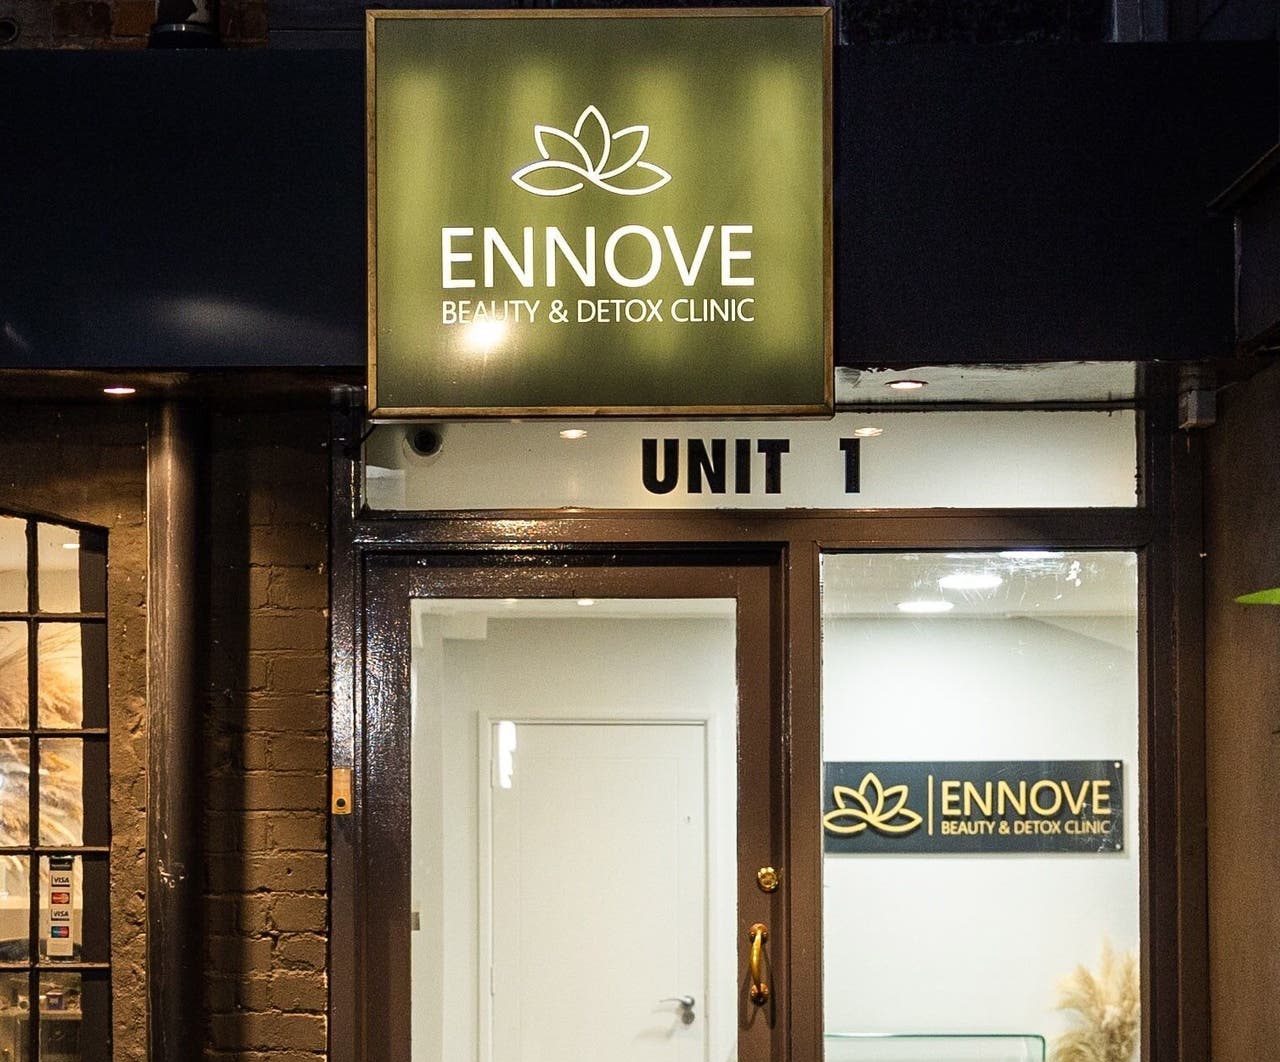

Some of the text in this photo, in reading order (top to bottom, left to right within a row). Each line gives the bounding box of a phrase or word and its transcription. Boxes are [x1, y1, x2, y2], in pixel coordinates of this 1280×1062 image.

[441, 225, 755, 289] ENNOVE
[442, 298, 754, 324] BEAUTY & DETOX CLINIC
[642, 438, 862, 494] UNIT 1
[941, 780, 1112, 816] ENNOVE
[941, 820, 1111, 835] BEAUTY & DETOX CLINIC
